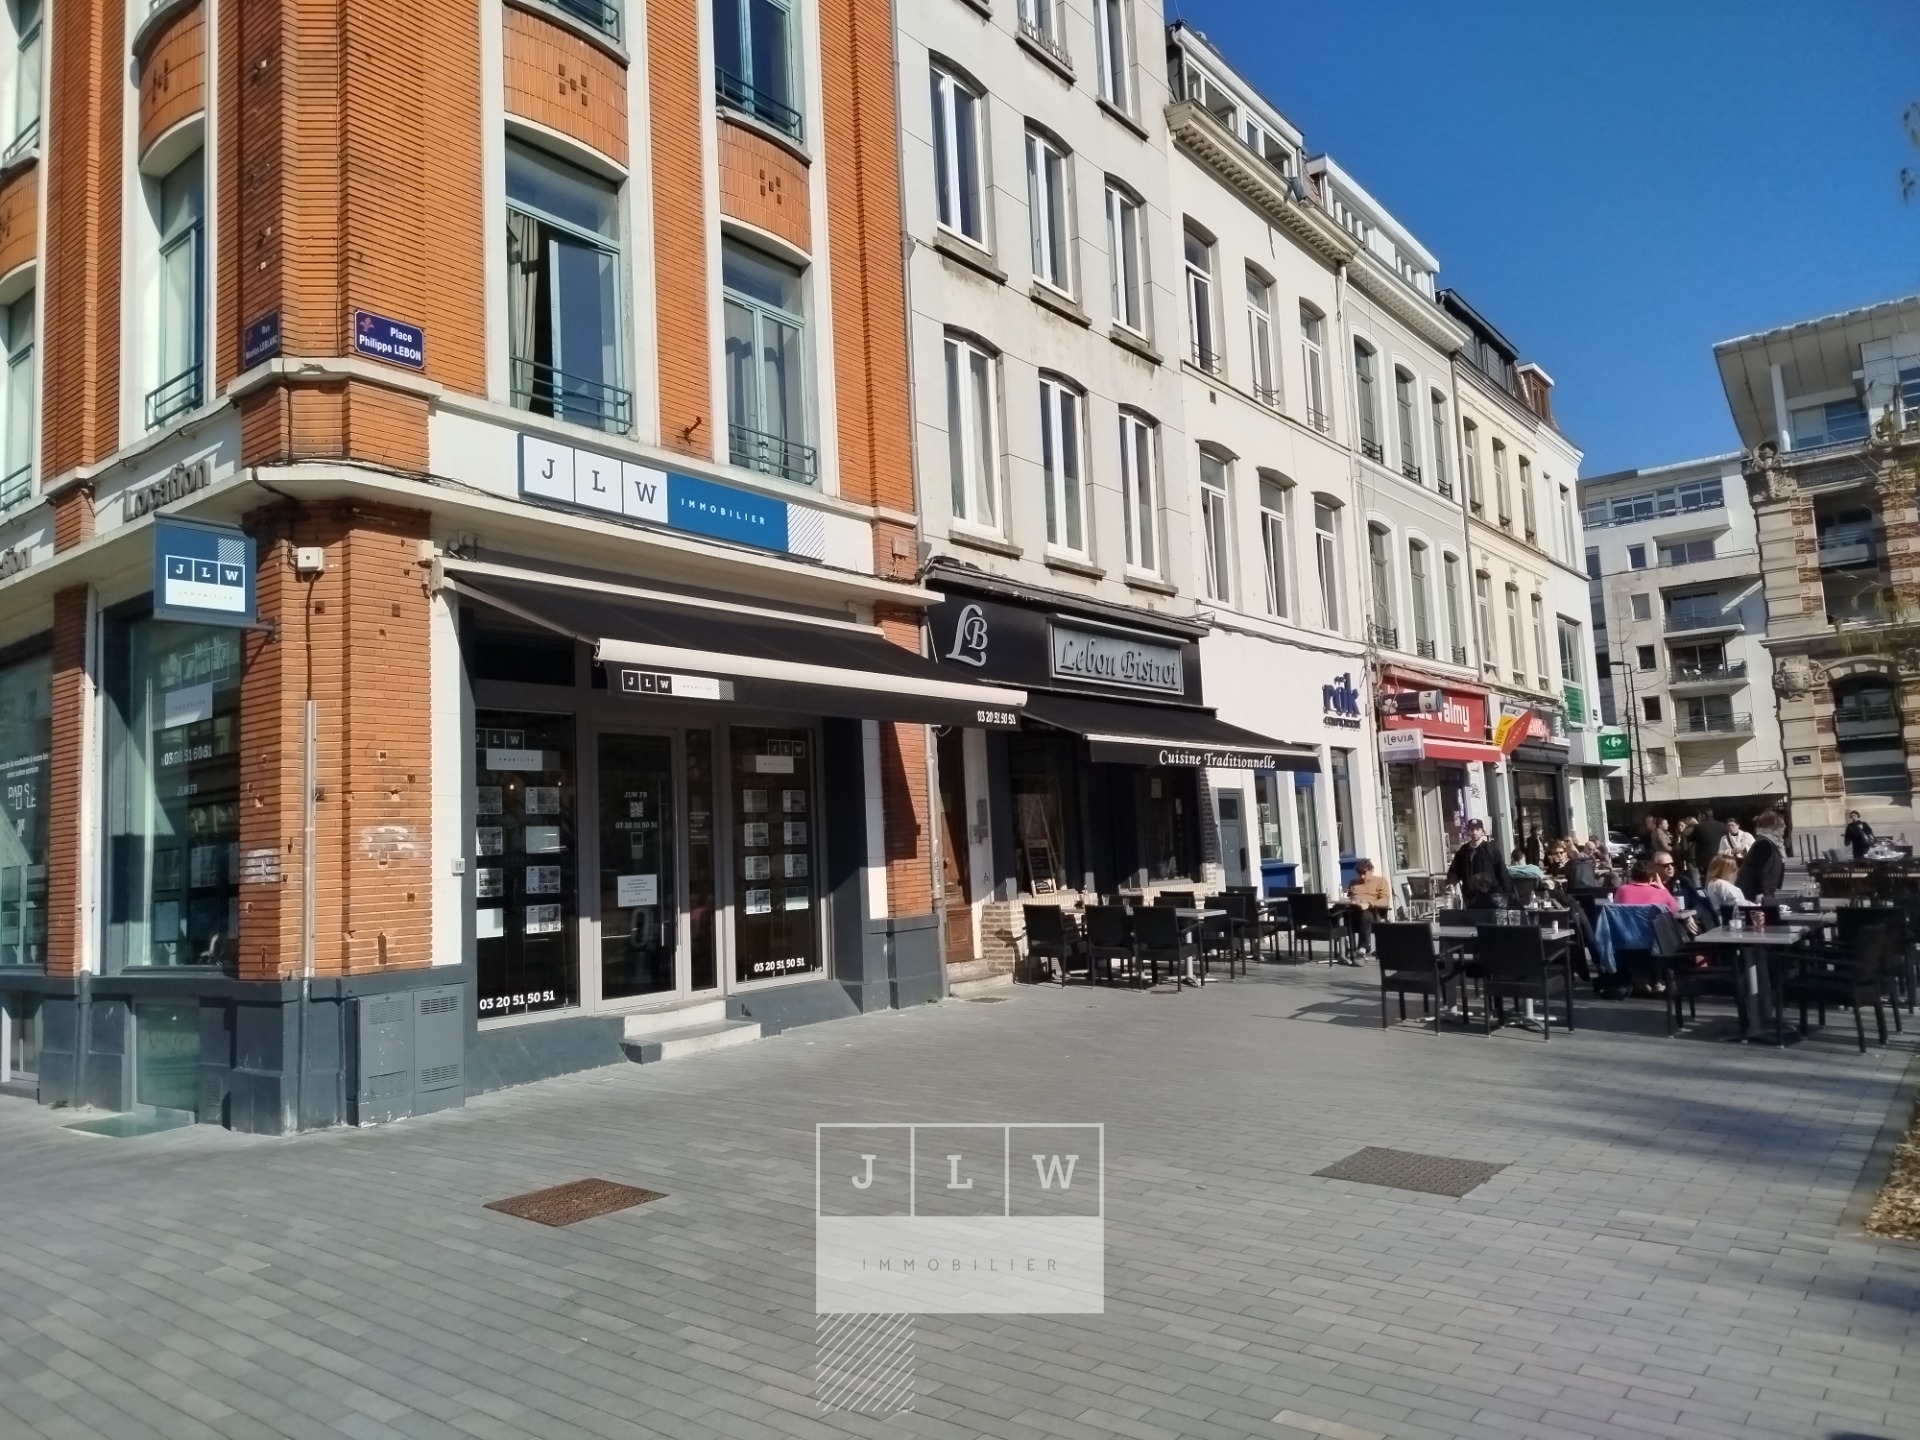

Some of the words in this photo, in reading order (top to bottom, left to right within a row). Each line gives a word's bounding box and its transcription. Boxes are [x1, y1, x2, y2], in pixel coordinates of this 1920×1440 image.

[390, 327, 413, 342] Place
[359, 334, 392, 353] Philippe
[394, 344, 421, 361] LEBON
[123, 459, 211, 522] Location
[680, 498, 765, 525] IMMOBILIER
[1060, 637, 1116, 676] Lebon
[1121, 650, 1176, 685] Bistrot
[977, 710, 985, 722] 03
[986, 711, 993, 723] 20
[164, 752, 173, 766] 03
[1159, 750, 1201, 765] Cuisine
[1204, 752, 1276, 769] Traditionnelle
[754, 961, 764, 973] 03
[765, 961, 775, 971] 20
[776, 960, 785, 970] 51
[786, 958, 795, 968] 50
[796, 957, 805, 967] 51
[479, 998, 494, 1010] 03
[496, 996, 510, 1008] 20
[513, 994, 525, 1006] 51
[527, 992, 541, 1004] 50
[543, 990, 555, 1002] 51
